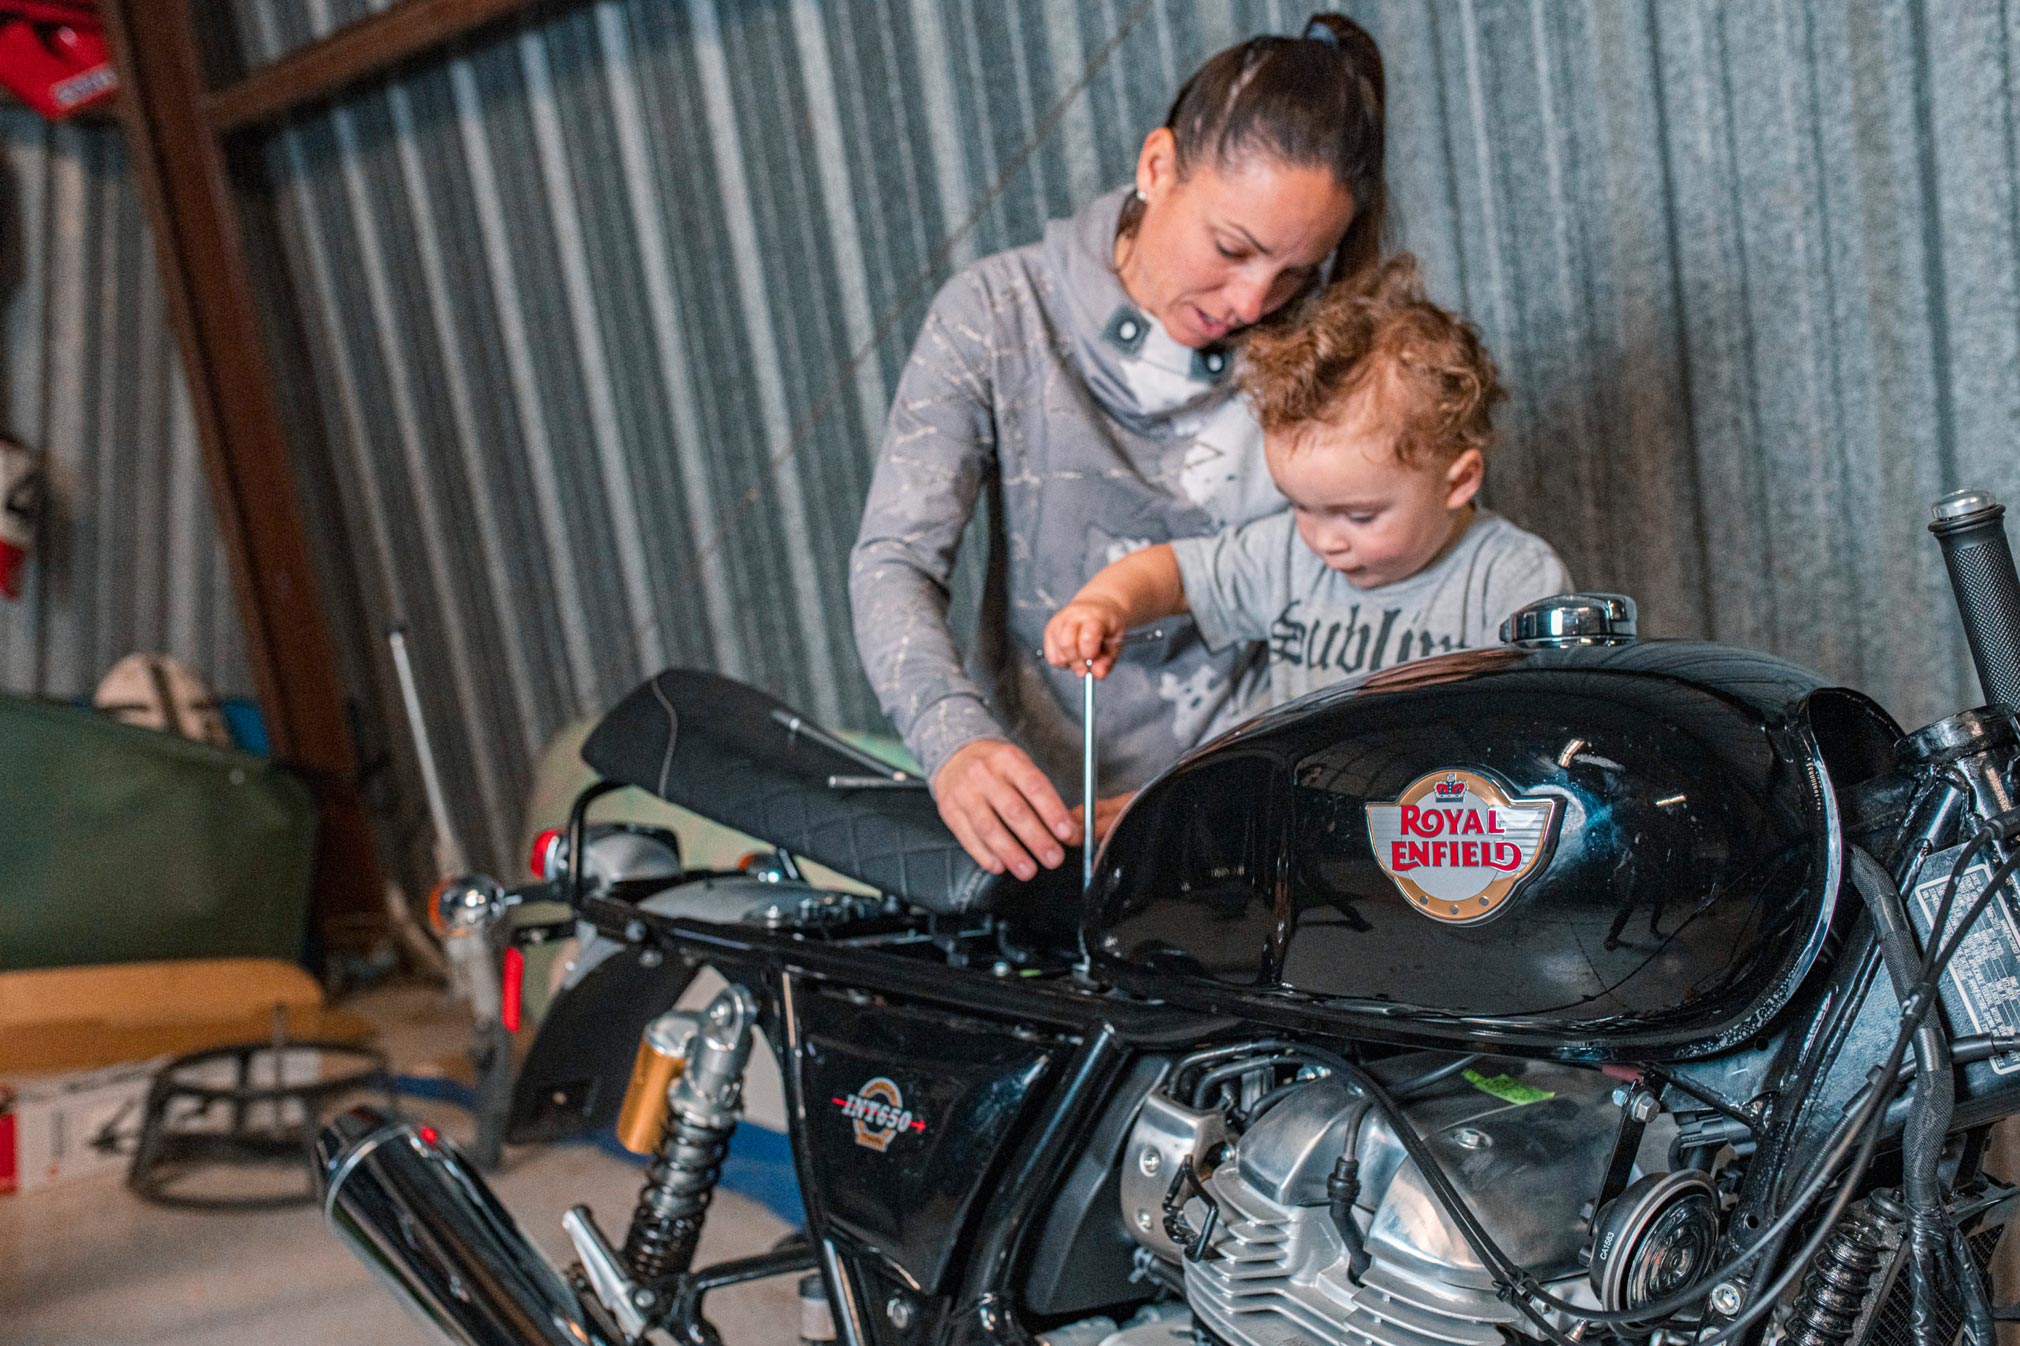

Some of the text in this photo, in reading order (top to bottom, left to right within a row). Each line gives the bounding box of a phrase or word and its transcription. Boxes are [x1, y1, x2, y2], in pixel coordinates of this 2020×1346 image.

[1400, 804, 1505, 838] ROYAL
[1391, 840, 1522, 872] ENFIELD
[841, 1094, 912, 1132] INT650
